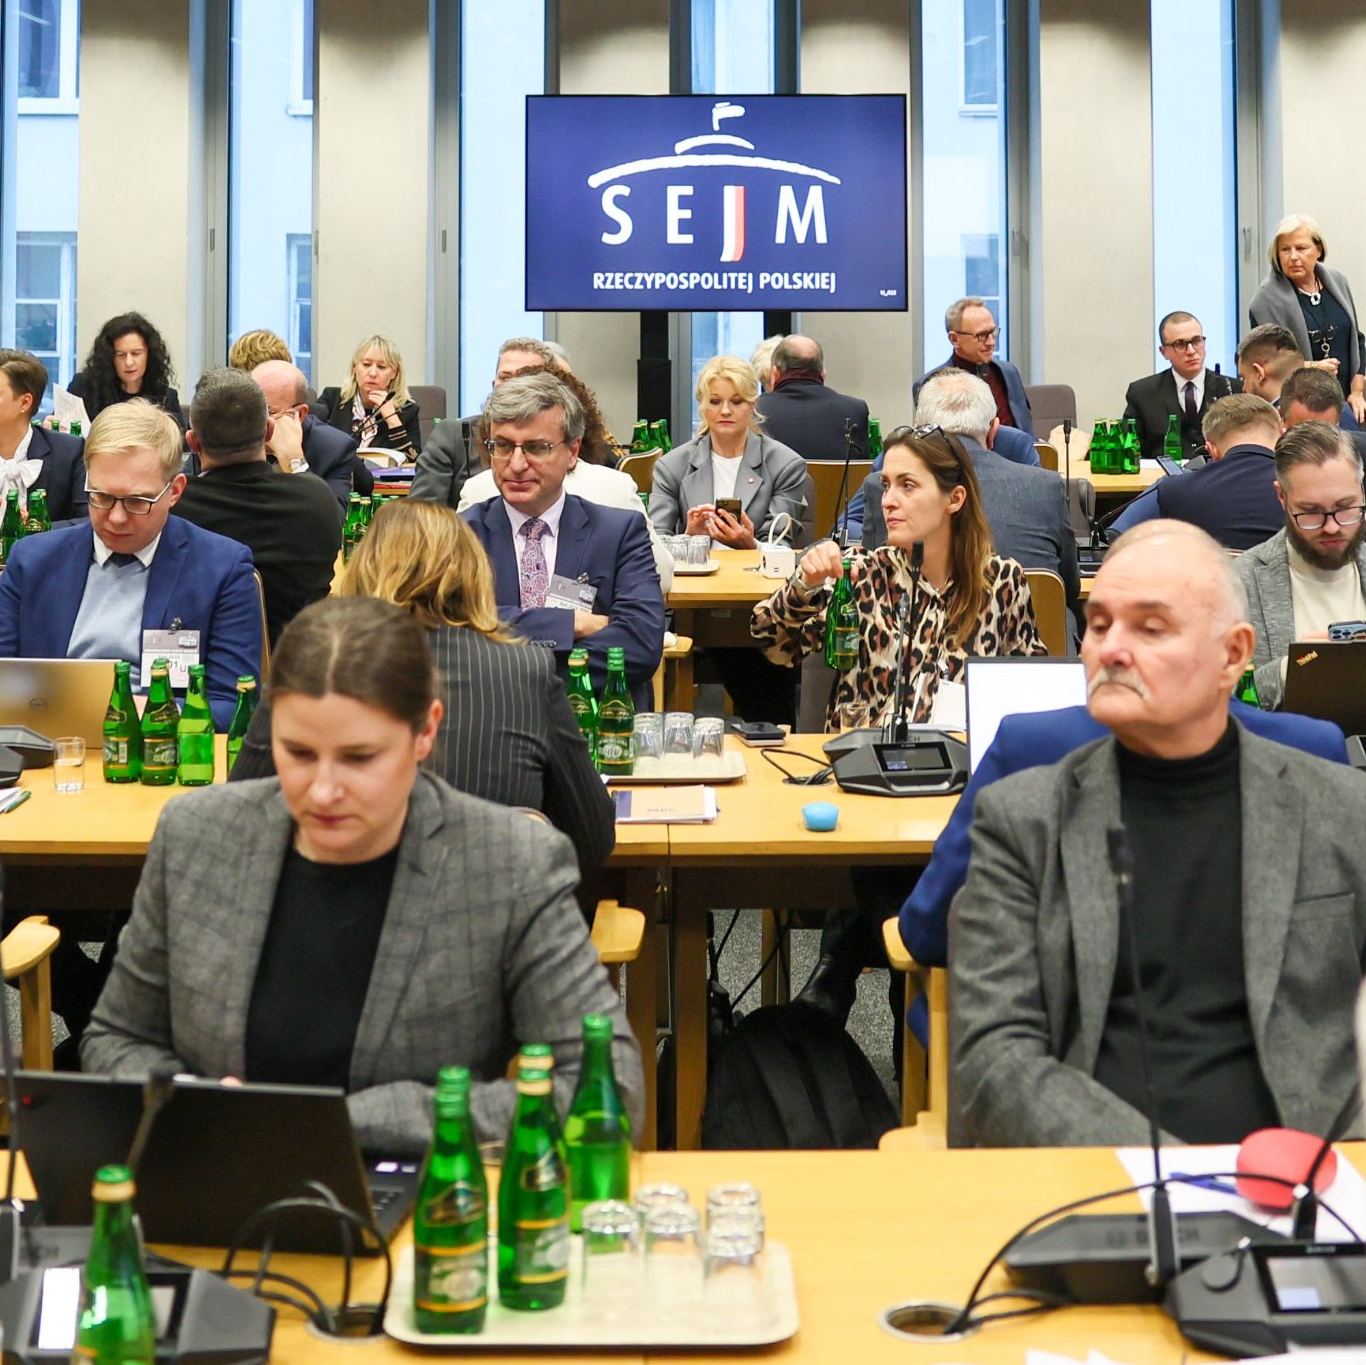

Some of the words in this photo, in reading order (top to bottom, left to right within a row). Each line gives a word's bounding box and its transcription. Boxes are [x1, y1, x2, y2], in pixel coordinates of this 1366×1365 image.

[600, 184, 829, 263] SEJM
[593, 272, 755, 294] RZECZYPOSPOLITEJ
[759, 272, 837, 294] POLSKIEJ
